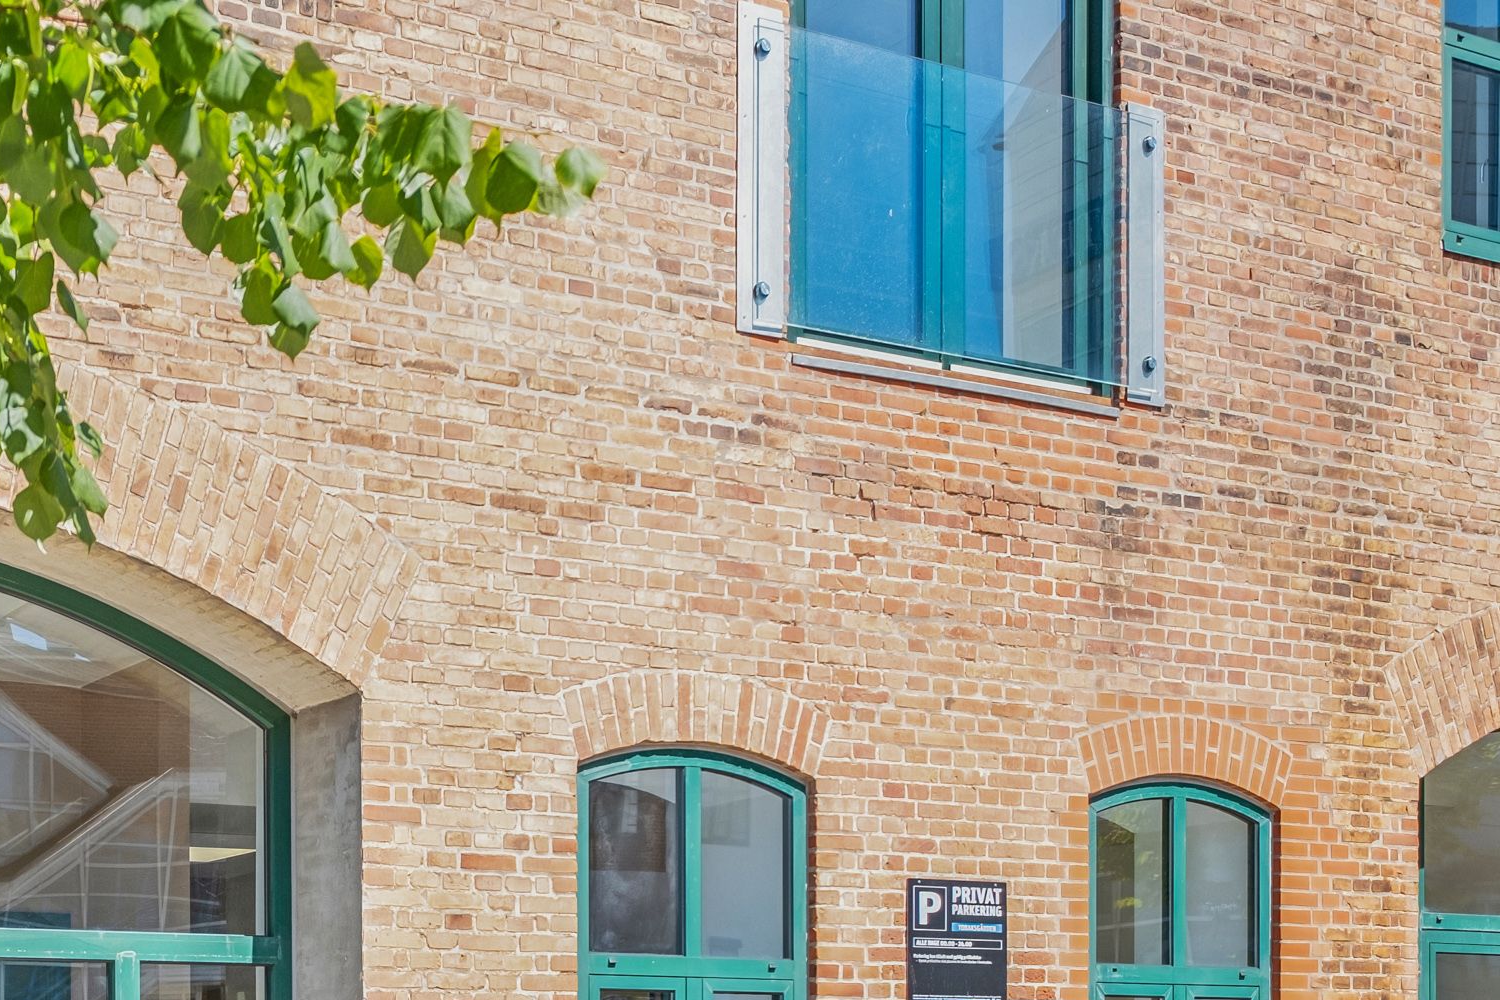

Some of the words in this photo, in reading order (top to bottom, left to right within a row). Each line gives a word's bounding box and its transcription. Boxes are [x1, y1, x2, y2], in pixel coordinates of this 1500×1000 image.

[952, 886, 1003, 905] PRIVAT
[919, 891, 942, 926] P
[951, 904, 1003, 917] PARKERING
